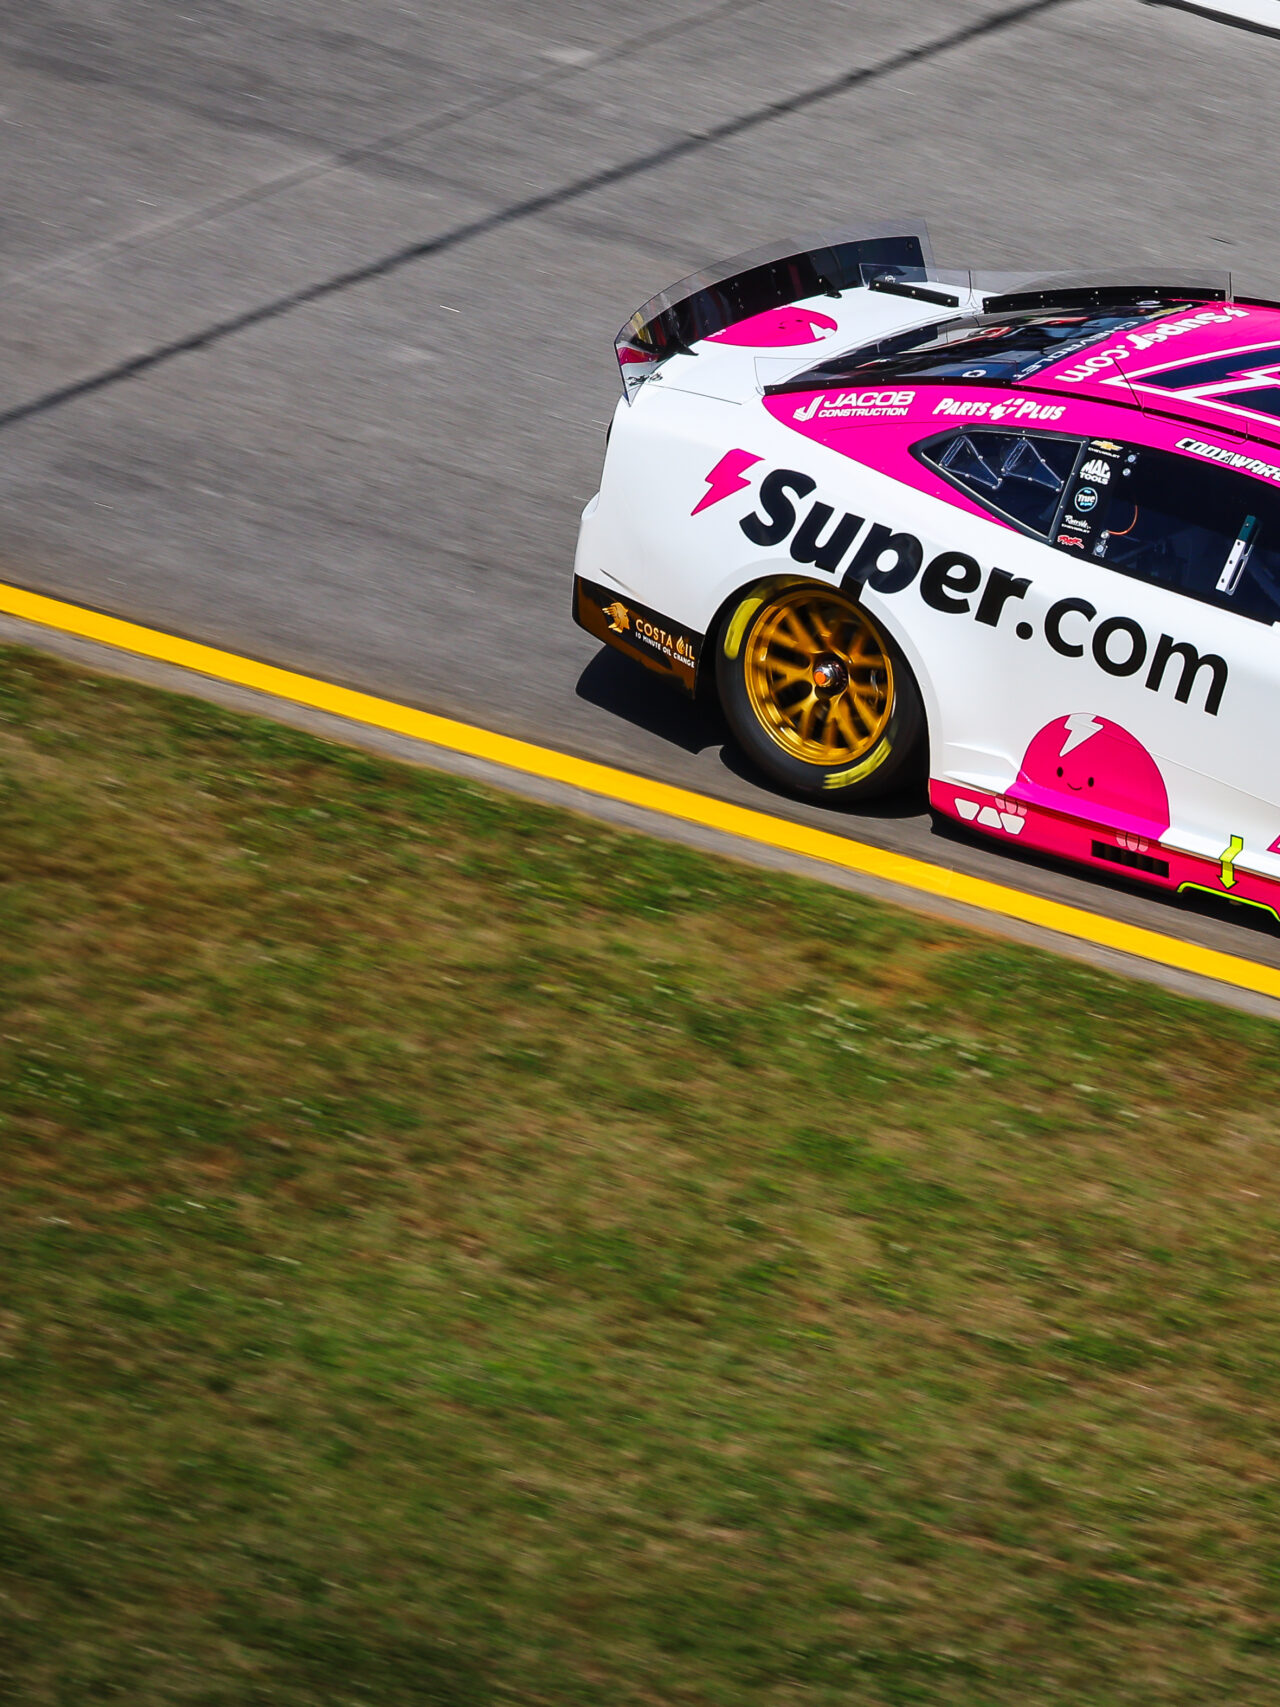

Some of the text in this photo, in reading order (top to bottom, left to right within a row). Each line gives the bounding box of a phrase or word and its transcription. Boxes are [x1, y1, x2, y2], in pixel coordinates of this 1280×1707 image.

[1054, 308, 1233, 383] Super.com
[823, 391, 916, 408] JACOB
[932, 398, 1067, 421] PARTS PLUS
[818, 407, 909, 418] CONSTRUCTION
[1079, 471, 1109, 486] TOOLS
[1080, 459, 1111, 479] MAC
[738, 468, 1229, 717] Super.com
[635, 619, 673, 649] COSTA
[642, 635, 661, 650] MINUTE
[662, 646, 672, 657] OIL
[673, 652, 695, 669] CHANGE
